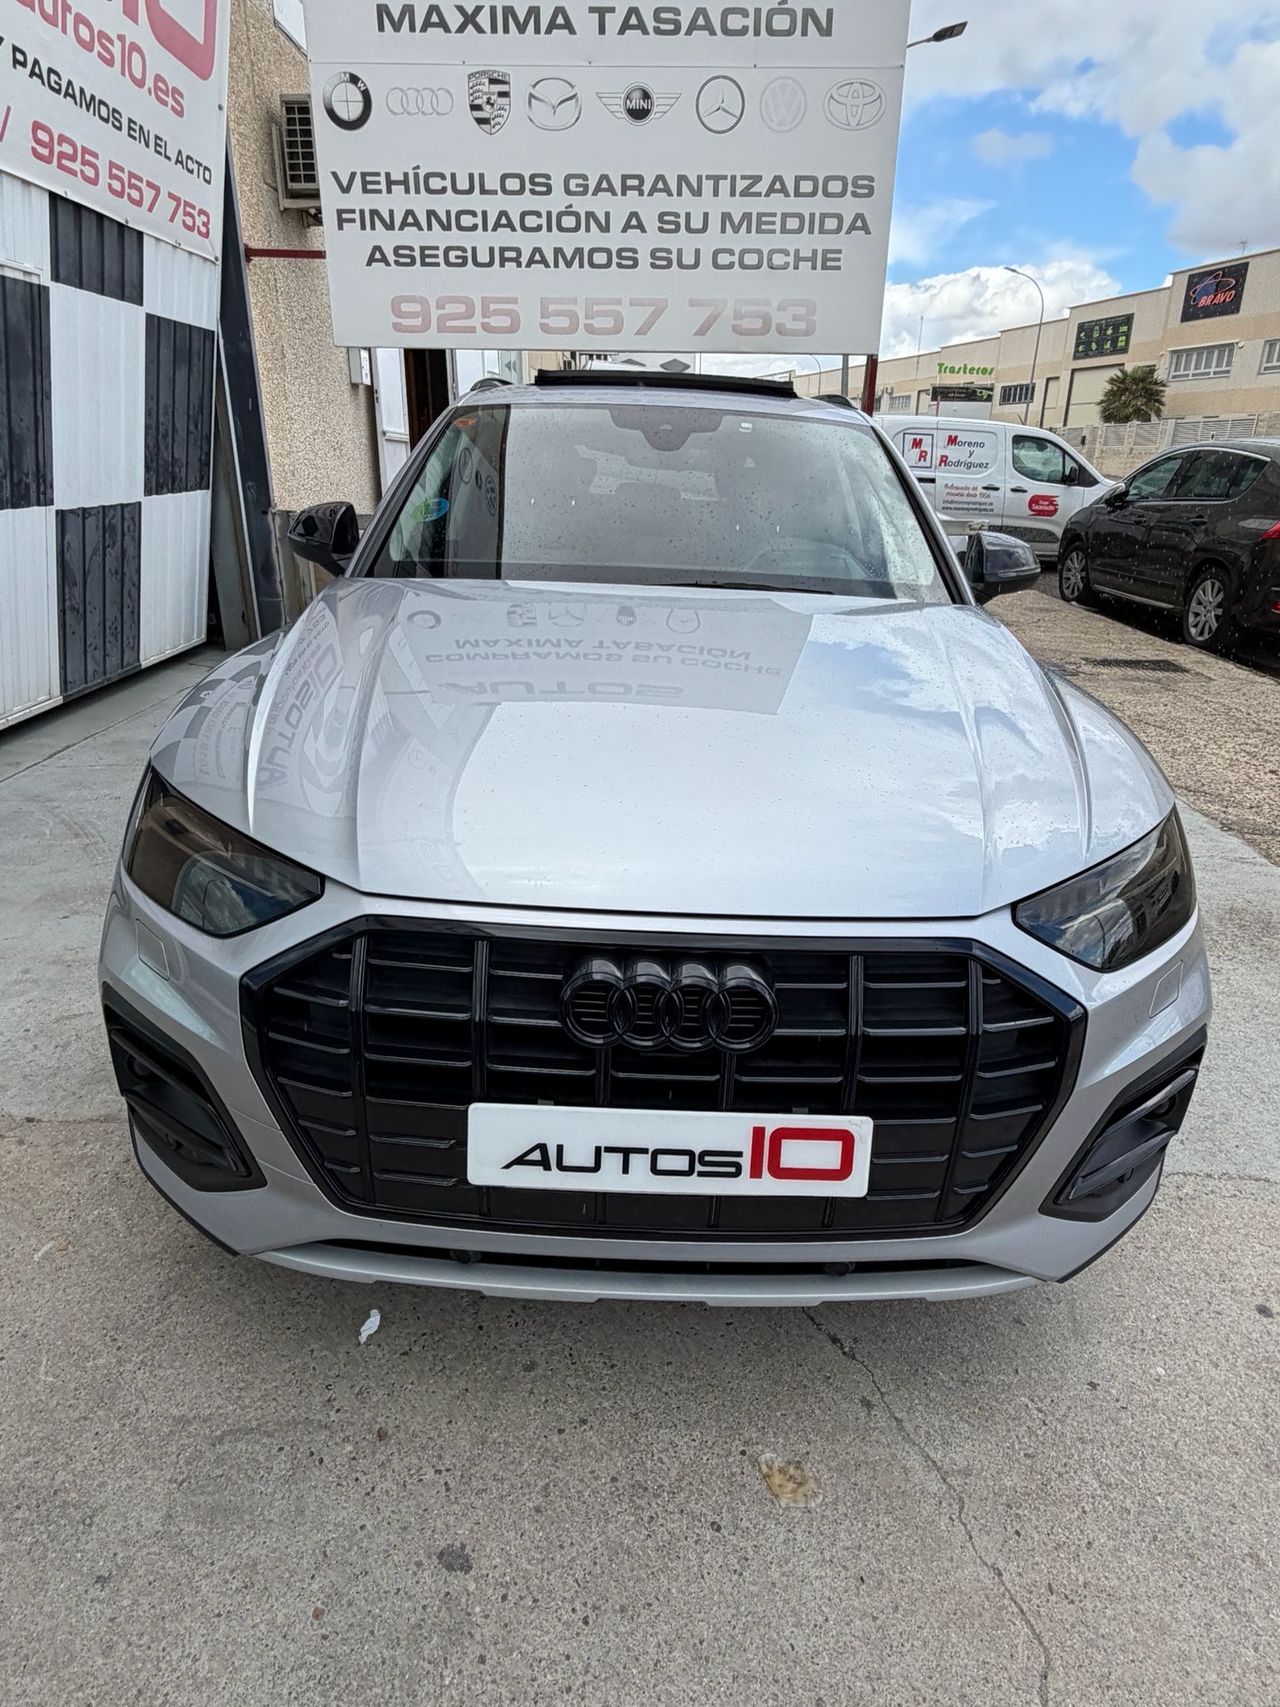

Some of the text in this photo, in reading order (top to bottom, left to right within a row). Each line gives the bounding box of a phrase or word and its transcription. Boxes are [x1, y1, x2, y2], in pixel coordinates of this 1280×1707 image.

[376, 0, 835, 38] MAXIMA TASACIÓN
[16, 0, 185, 118] utos10.es
[11, 43, 213, 185] PAGAMOS EN EL ACTO
[626, 97, 652, 111] MINI
[31, 120, 100, 186] 925
[108, 159, 161, 213] 557
[167, 191, 211, 239] 753
[330, 166, 876, 199] VEHÍCULOS GARANTIZADOS
[336, 203, 872, 236] FINANCIACIÓN A SU MEDIDA
[365, 245, 842, 272] ASEGURAMOS SU COCHE
[1198, 290, 1236, 307] BRAVO
[390, 295, 818, 338] 925 557 753
[937, 362, 995, 376] Trasteros
[945, 435, 985, 449] Moreno
[968, 449, 975, 459] y
[501, 1125, 855, 1182] AUTOS10
